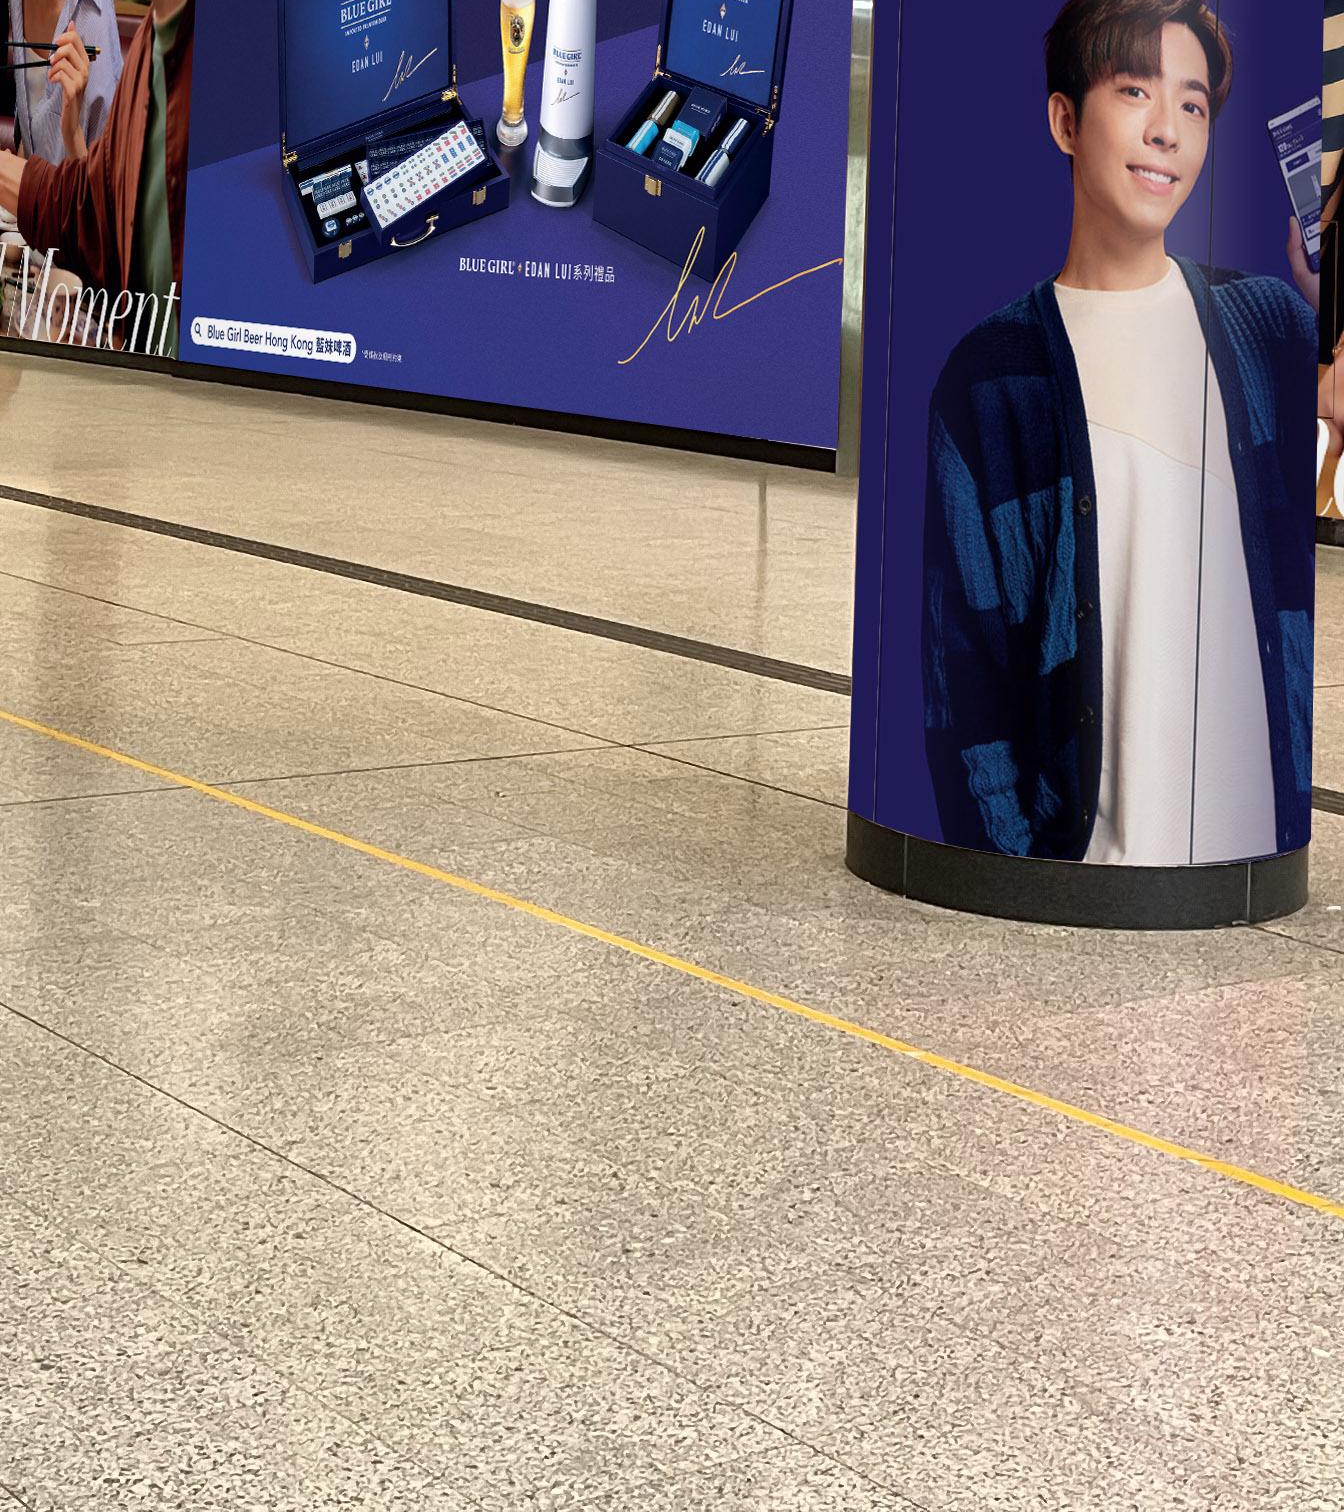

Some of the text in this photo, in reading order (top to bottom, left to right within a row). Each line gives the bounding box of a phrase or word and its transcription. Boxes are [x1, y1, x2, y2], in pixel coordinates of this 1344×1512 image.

[341, 1, 366, 24] BLUE
[702, 19, 740, 43] EDAN LUI
[351, 57, 369, 73] EDAN
[459, 257, 486, 272] BLUE
[525, 261, 550, 278] EDAN
[6, 242, 182, 360] Moment
[207, 324, 351, 358] Blue Girl Beer Hong Kong 藍妹啤酒
